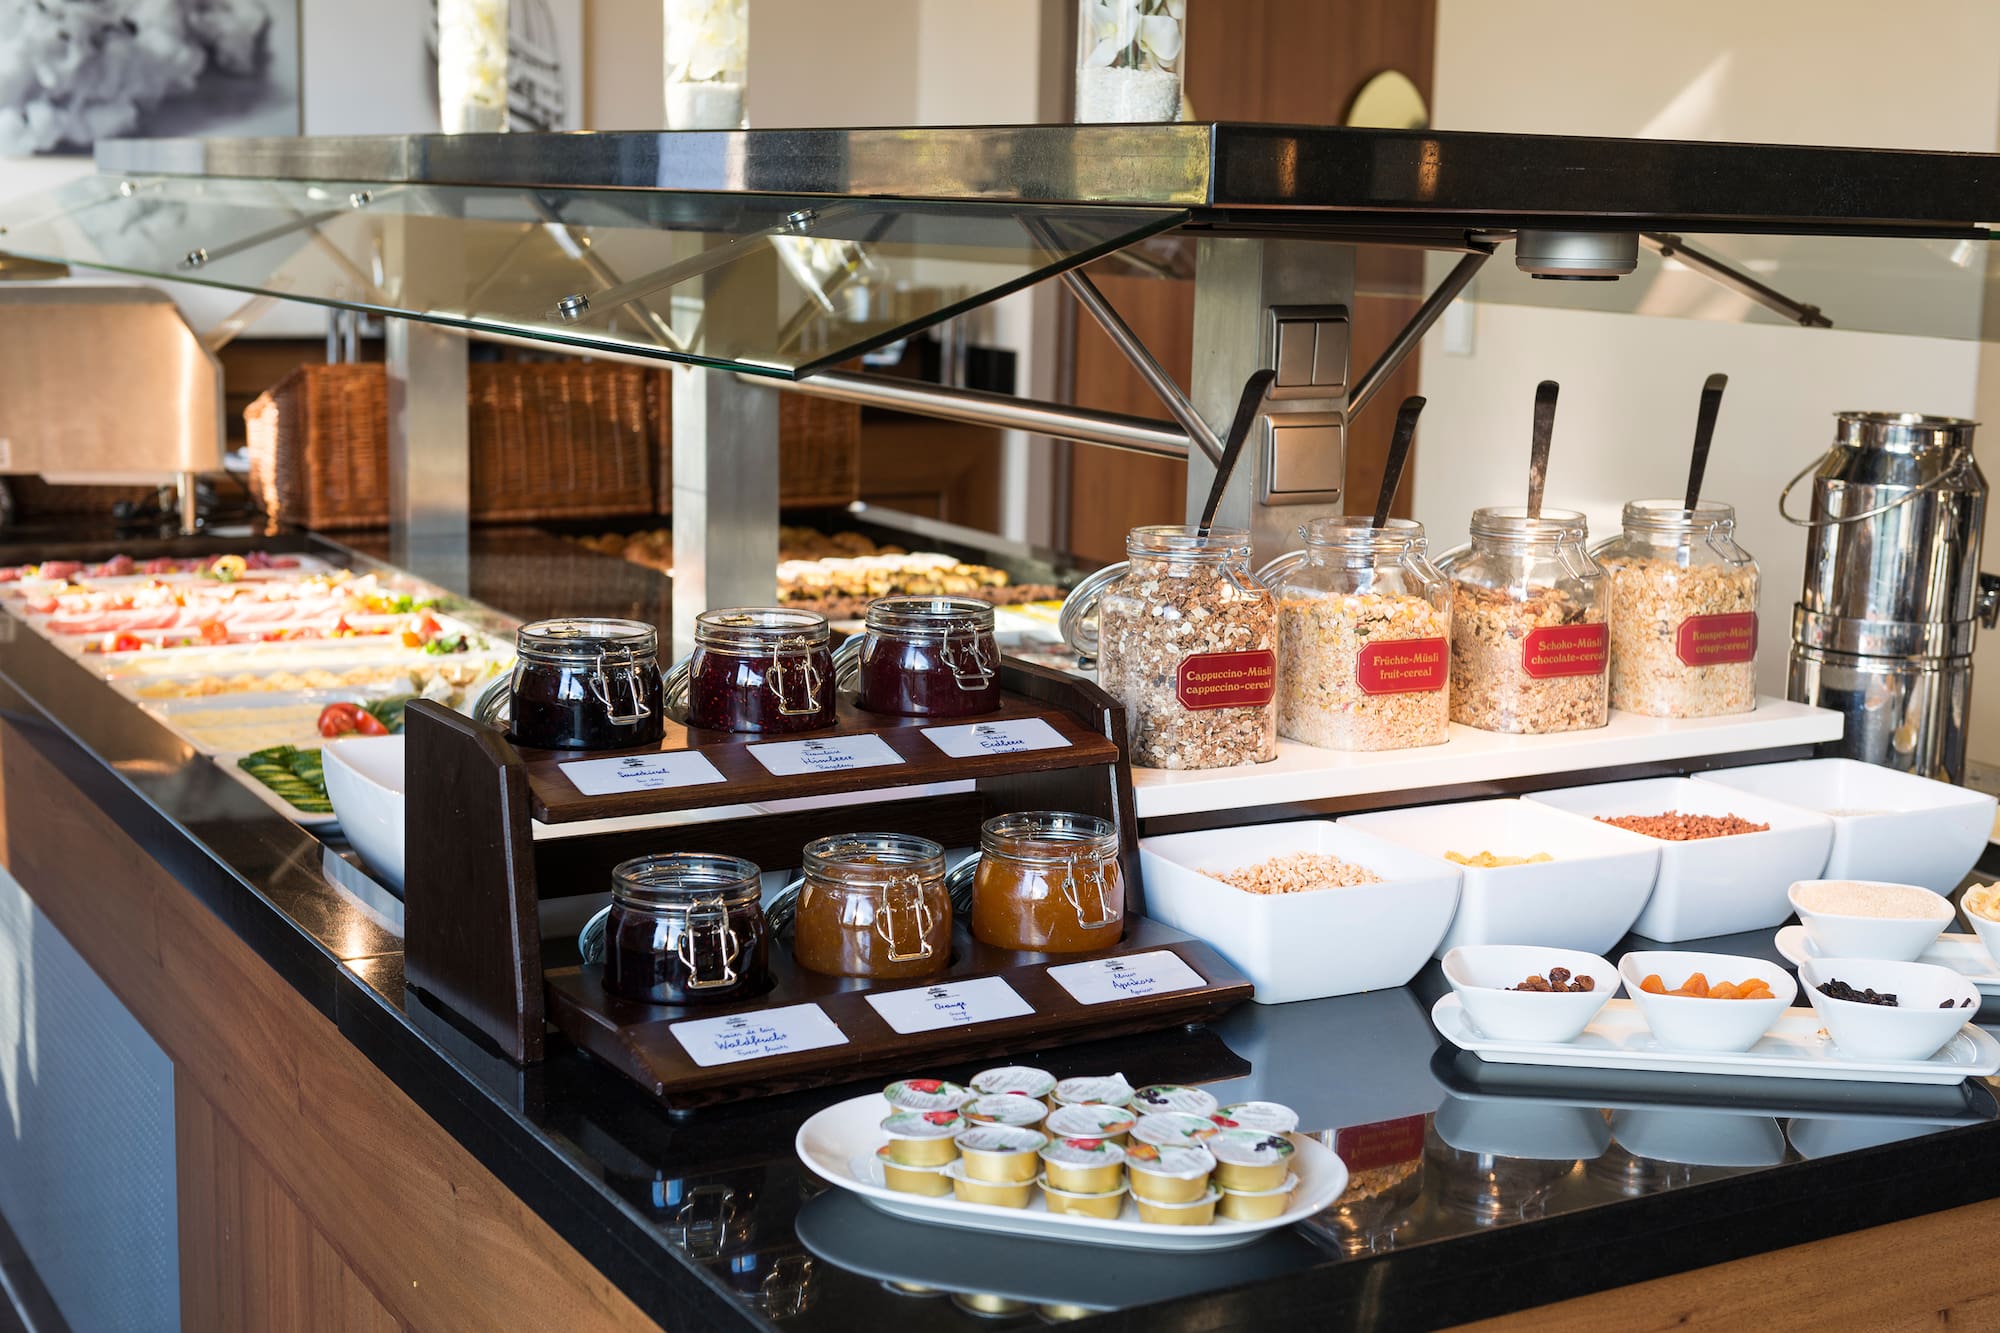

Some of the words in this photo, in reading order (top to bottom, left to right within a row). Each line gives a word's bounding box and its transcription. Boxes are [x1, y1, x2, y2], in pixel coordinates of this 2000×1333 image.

[1538, 638, 1602, 651] Schoko-Müsli
[1696, 640, 1749, 654] crispy-cereal
[1373, 652, 1439, 666] Früchte-Müsli
[1531, 650, 1605, 665] chocolate-cereal
[1186, 666, 1272, 681] Cappuccino-Müsli
[1380, 667, 1432, 680] fruit-cereal
[1186, 679, 1271, 695] cappuccino-cereal
[980, 739, 1025, 748] Erdbeere
[801, 755, 854, 765] Himbeere
[934, 1002, 967, 1010] Orange
